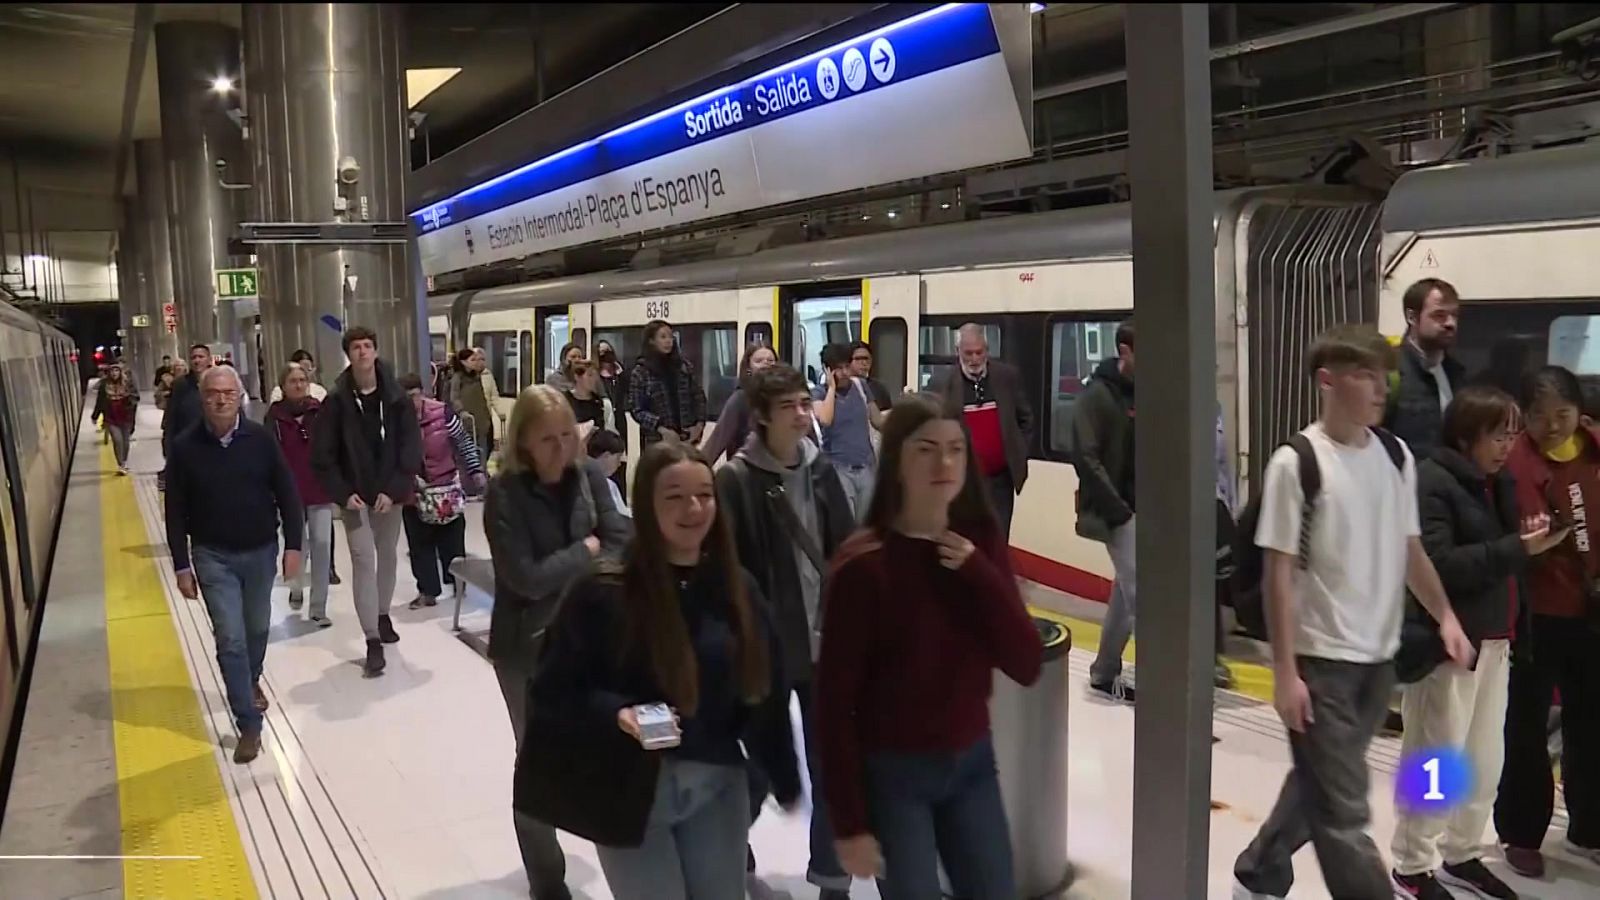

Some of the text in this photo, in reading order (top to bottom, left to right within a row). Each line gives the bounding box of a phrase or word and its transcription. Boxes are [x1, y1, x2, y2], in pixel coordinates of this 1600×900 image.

[684, 96, 744, 138] Sortida
[755, 73, 812, 115] Salida
[487, 167, 726, 249] Estació Intermodal-Plaça d'Espanya
[646, 301, 670, 318] 83-18
